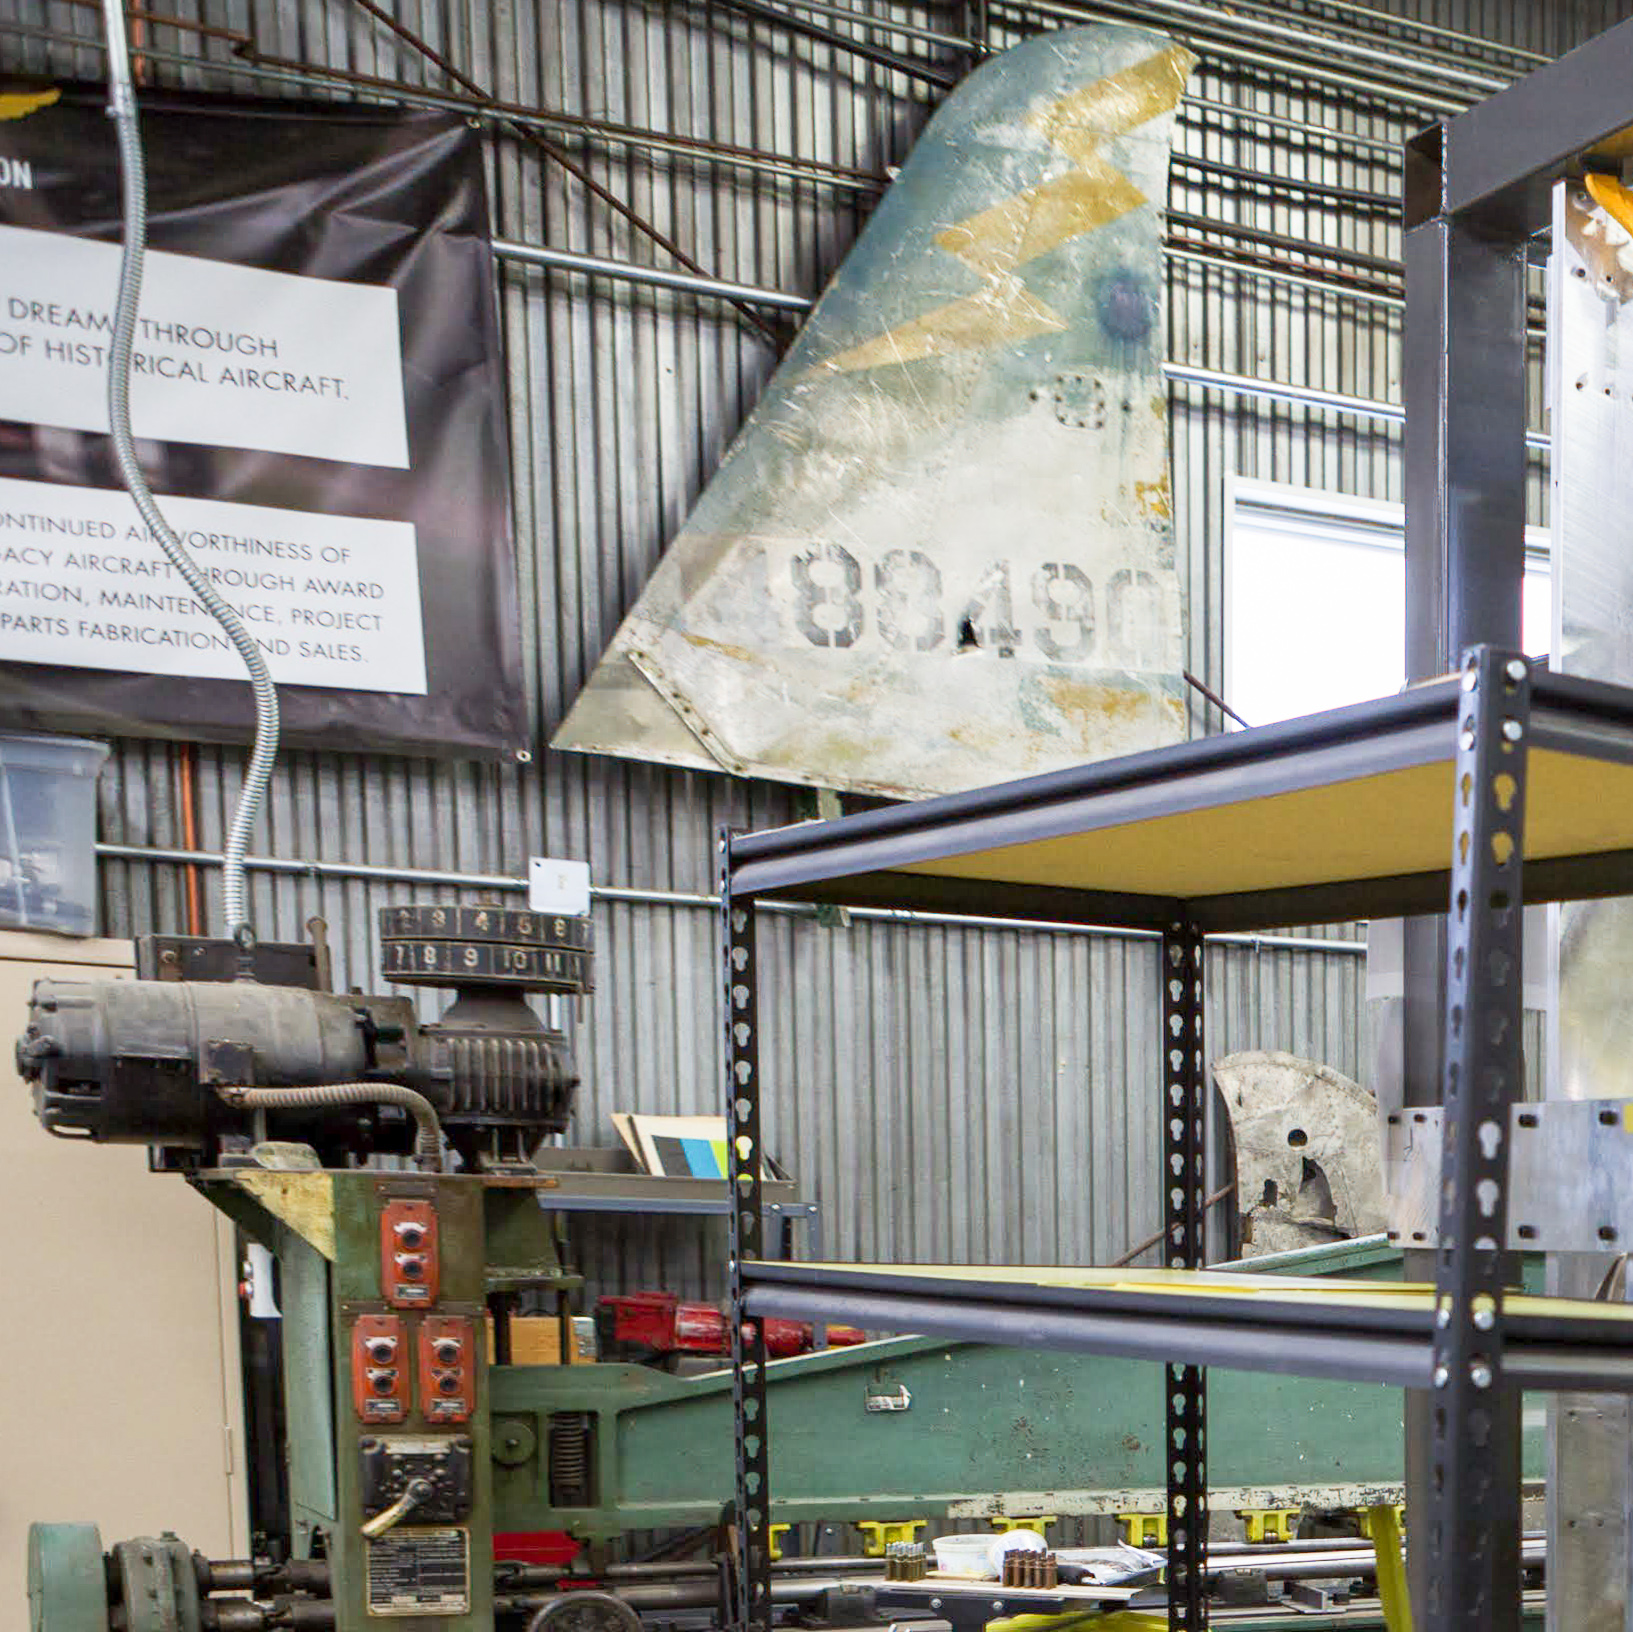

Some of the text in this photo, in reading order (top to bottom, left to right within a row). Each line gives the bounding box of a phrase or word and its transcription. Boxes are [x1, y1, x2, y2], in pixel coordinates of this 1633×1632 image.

[140, 318, 278, 358] THROUGH
[45, 339, 209, 383] HISTRICAL
[219, 367, 349, 400] AIRCRAFT.
[0, 512, 116, 539] NTINUED
[321, 546, 351, 564] OF
[0, 548, 384, 599] ACY AIRCRAFT HROUGH AWARD
[0, 580, 382, 631] ATION, MAINTENNCE, PROJECT
[1, 612, 70, 636] PARTS
[79, 621, 231, 650] FABRICATION
[299, 641, 369, 663] SALES.
[424, 946, 437, 965] 8
[463, 948, 479, 967] 9
[504, 950, 527, 969] 10
